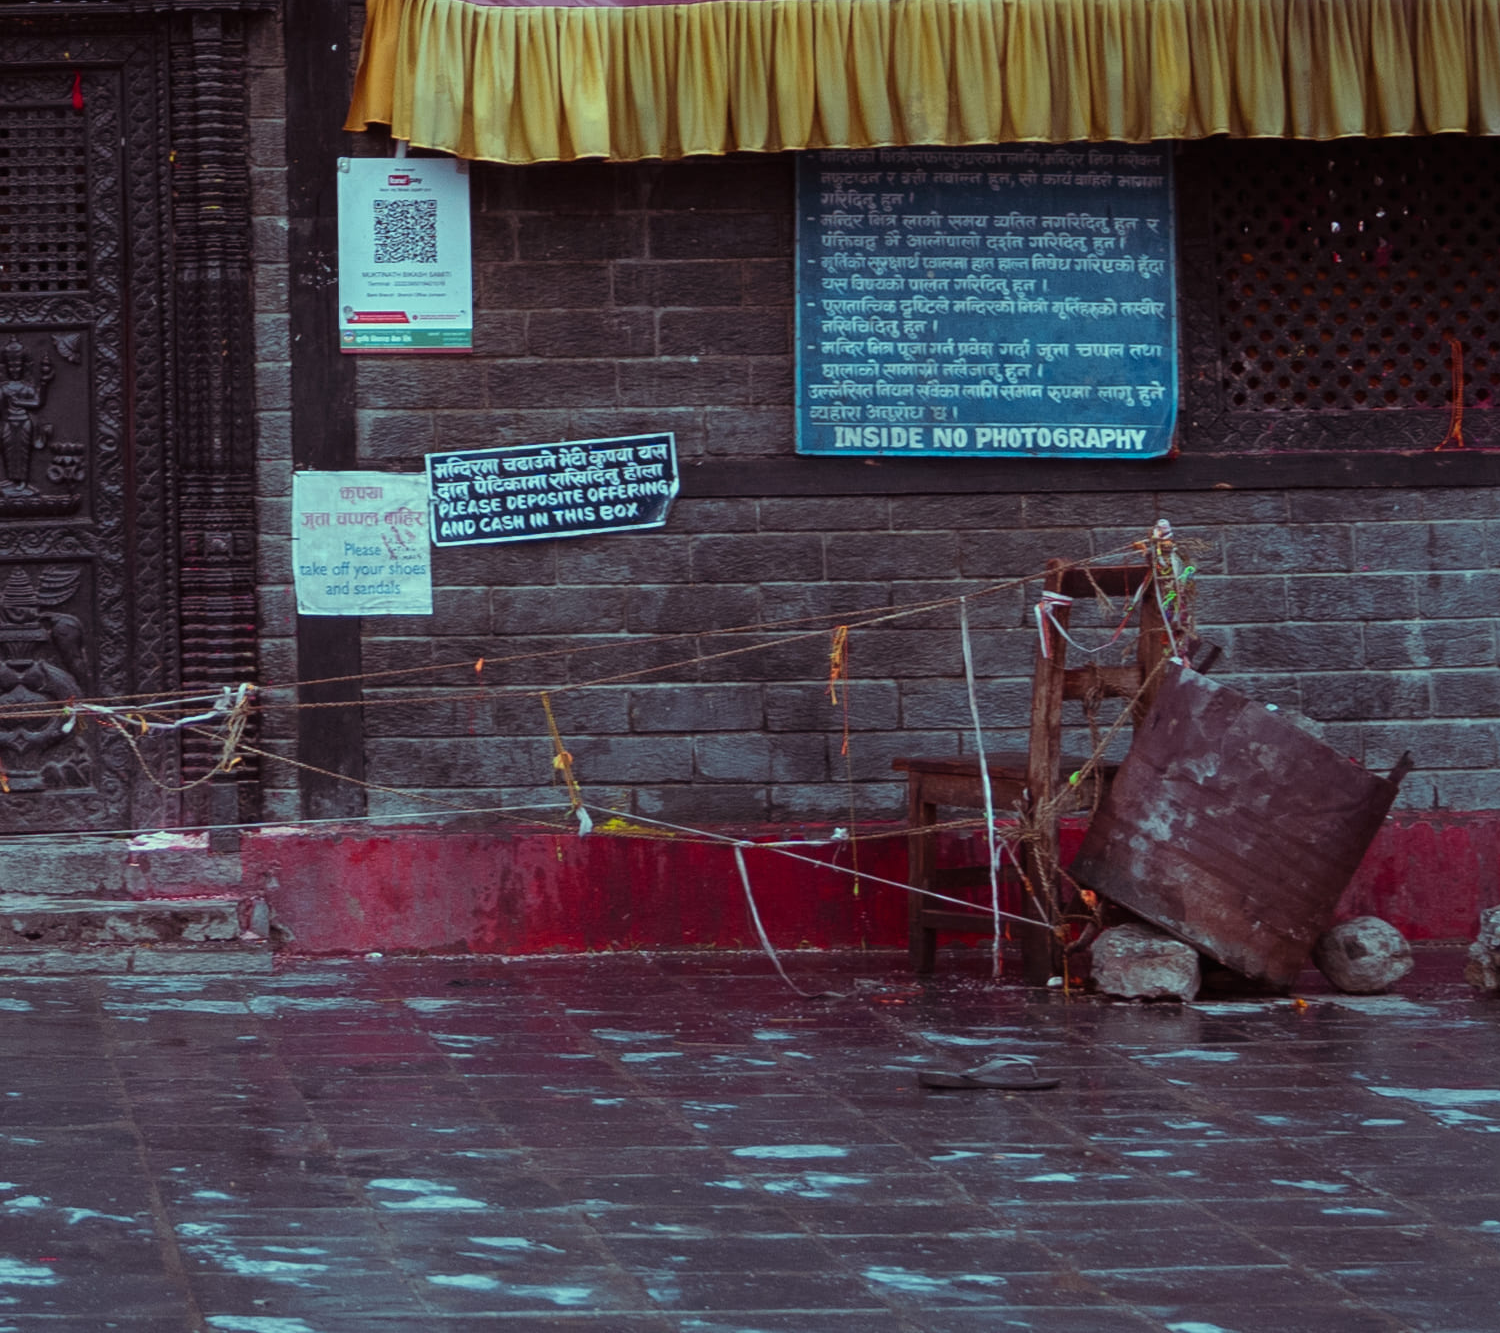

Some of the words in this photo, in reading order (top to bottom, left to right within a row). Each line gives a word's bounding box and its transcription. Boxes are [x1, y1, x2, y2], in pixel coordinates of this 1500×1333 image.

[820, 210, 865, 228] मन्दिर
[868, 210, 898, 226] भित्र
[948, 215, 988, 230] समय
[1146, 218, 1160, 233] र
[821, 278, 849, 294] यस
[907, 278, 951, 292] पालन
[953, 296, 1015, 316] मन्दिरको
[821, 336, 865, 356] मन्दिर
[867, 337, 894, 355] भित्र
[897, 341, 927, 361] पूजा
[1075, 343, 1125, 359] चप्पल
[1128, 344, 1163, 360] तथा
[962, 380, 998, 399] लागि
[1000, 385, 1043, 402] समान
[834, 426, 925, 449] INSIDE
[932, 427, 969, 449] NO
[975, 427, 1147, 450] PHOTOGRAPHY
[434, 457, 499, 479] मन्दिरमा
[589, 448, 634, 468] कृपया
[636, 443, 668, 461] यस
[622, 462, 664, 482] होला
[340, 485, 383, 504] कृपया
[438, 498, 502, 518] PLEASE
[506, 489, 584, 511] DEPOSITE
[587, 480, 669, 502] OFFERING
[440, 519, 476, 538] AND
[479, 514, 525, 534] CASH
[529, 511, 549, 528] IN
[552, 507, 596, 526] THIS
[600, 502, 639, 521] BOX
[344, 541, 382, 556] Please
[299, 561, 328, 575] take
[332, 561, 350, 575] off
[353, 564, 385, 579] your
[389, 562, 427, 575] shoes
[326, 581, 350, 595] and
[353, 580, 400, 595] sandals
